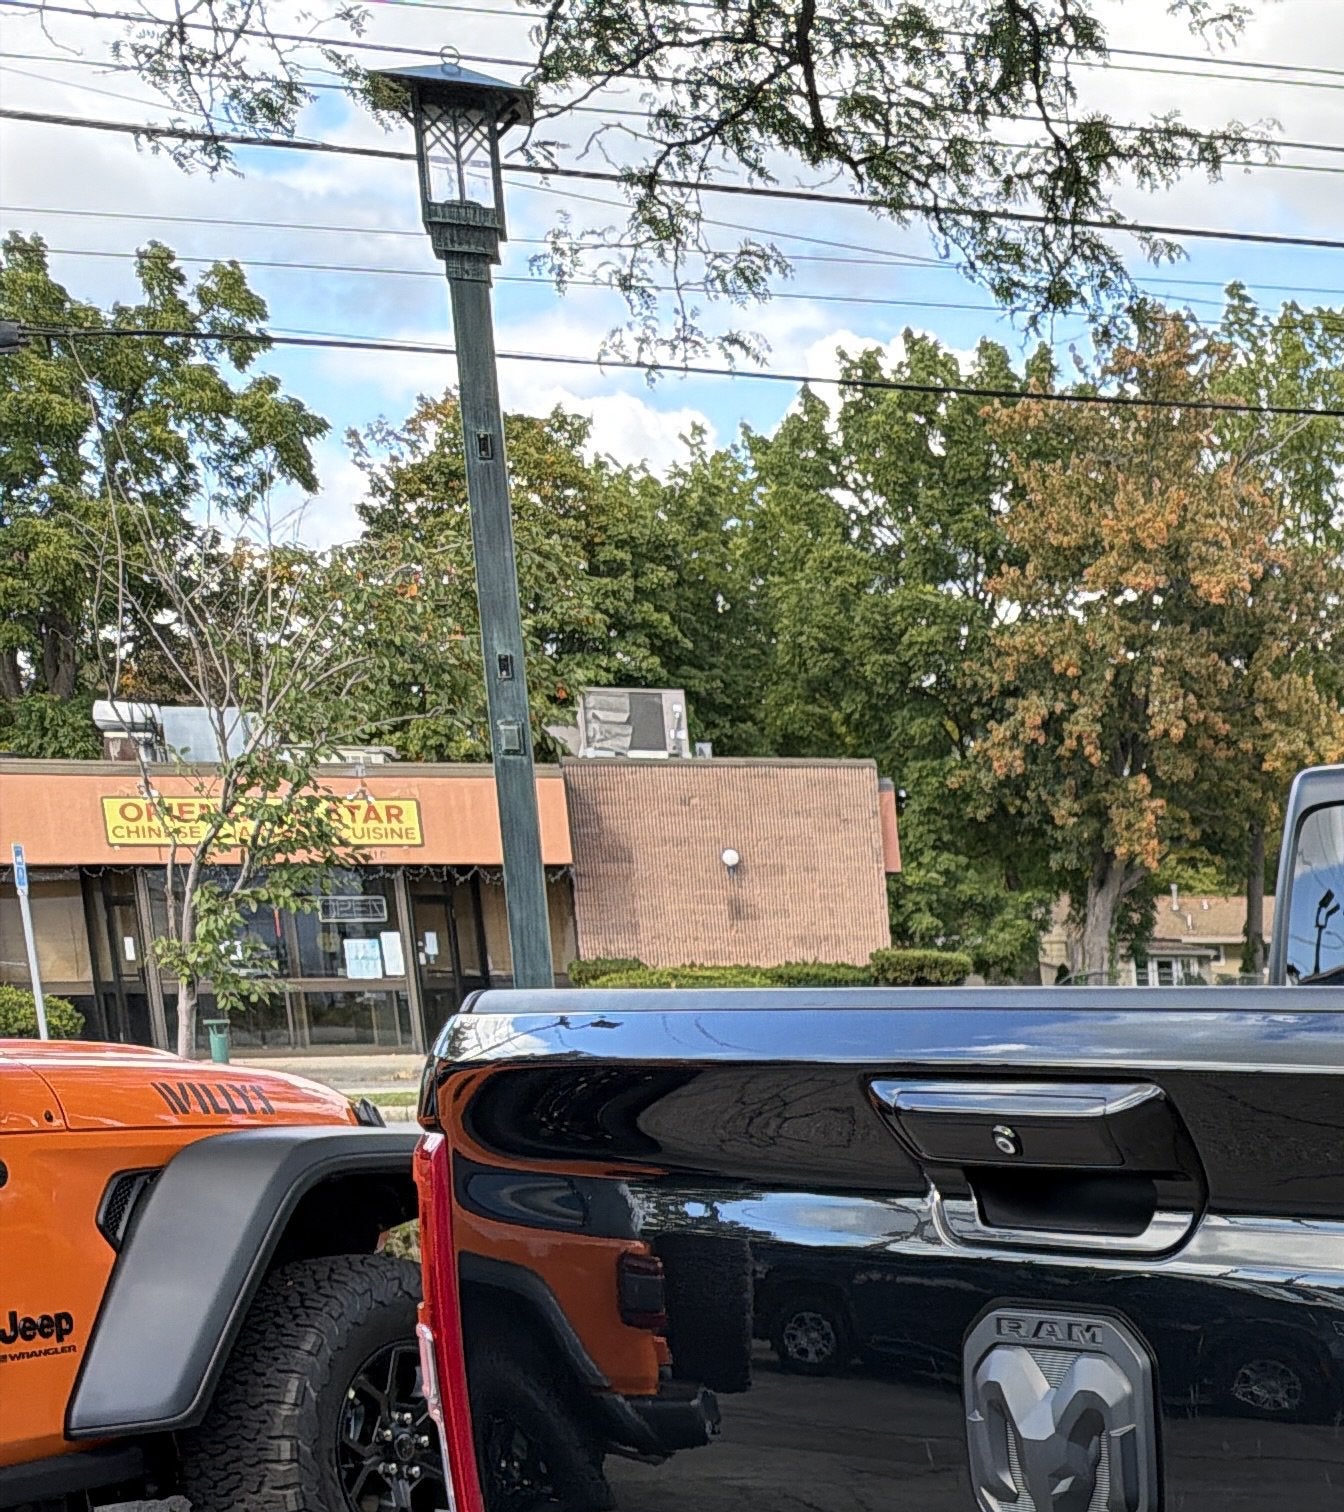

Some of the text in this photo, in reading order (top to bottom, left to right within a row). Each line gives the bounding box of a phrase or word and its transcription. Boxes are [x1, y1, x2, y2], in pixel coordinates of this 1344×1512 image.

[111, 825, 203, 840] CHINSE
[346, 826, 417, 841] UISINE
[150, 1082, 276, 1115] WILLYS
[0, 1311, 74, 1344] Jeep
[996, 1317, 1104, 1345] RAM
[8, 1345, 77, 1362] WRANGLER
